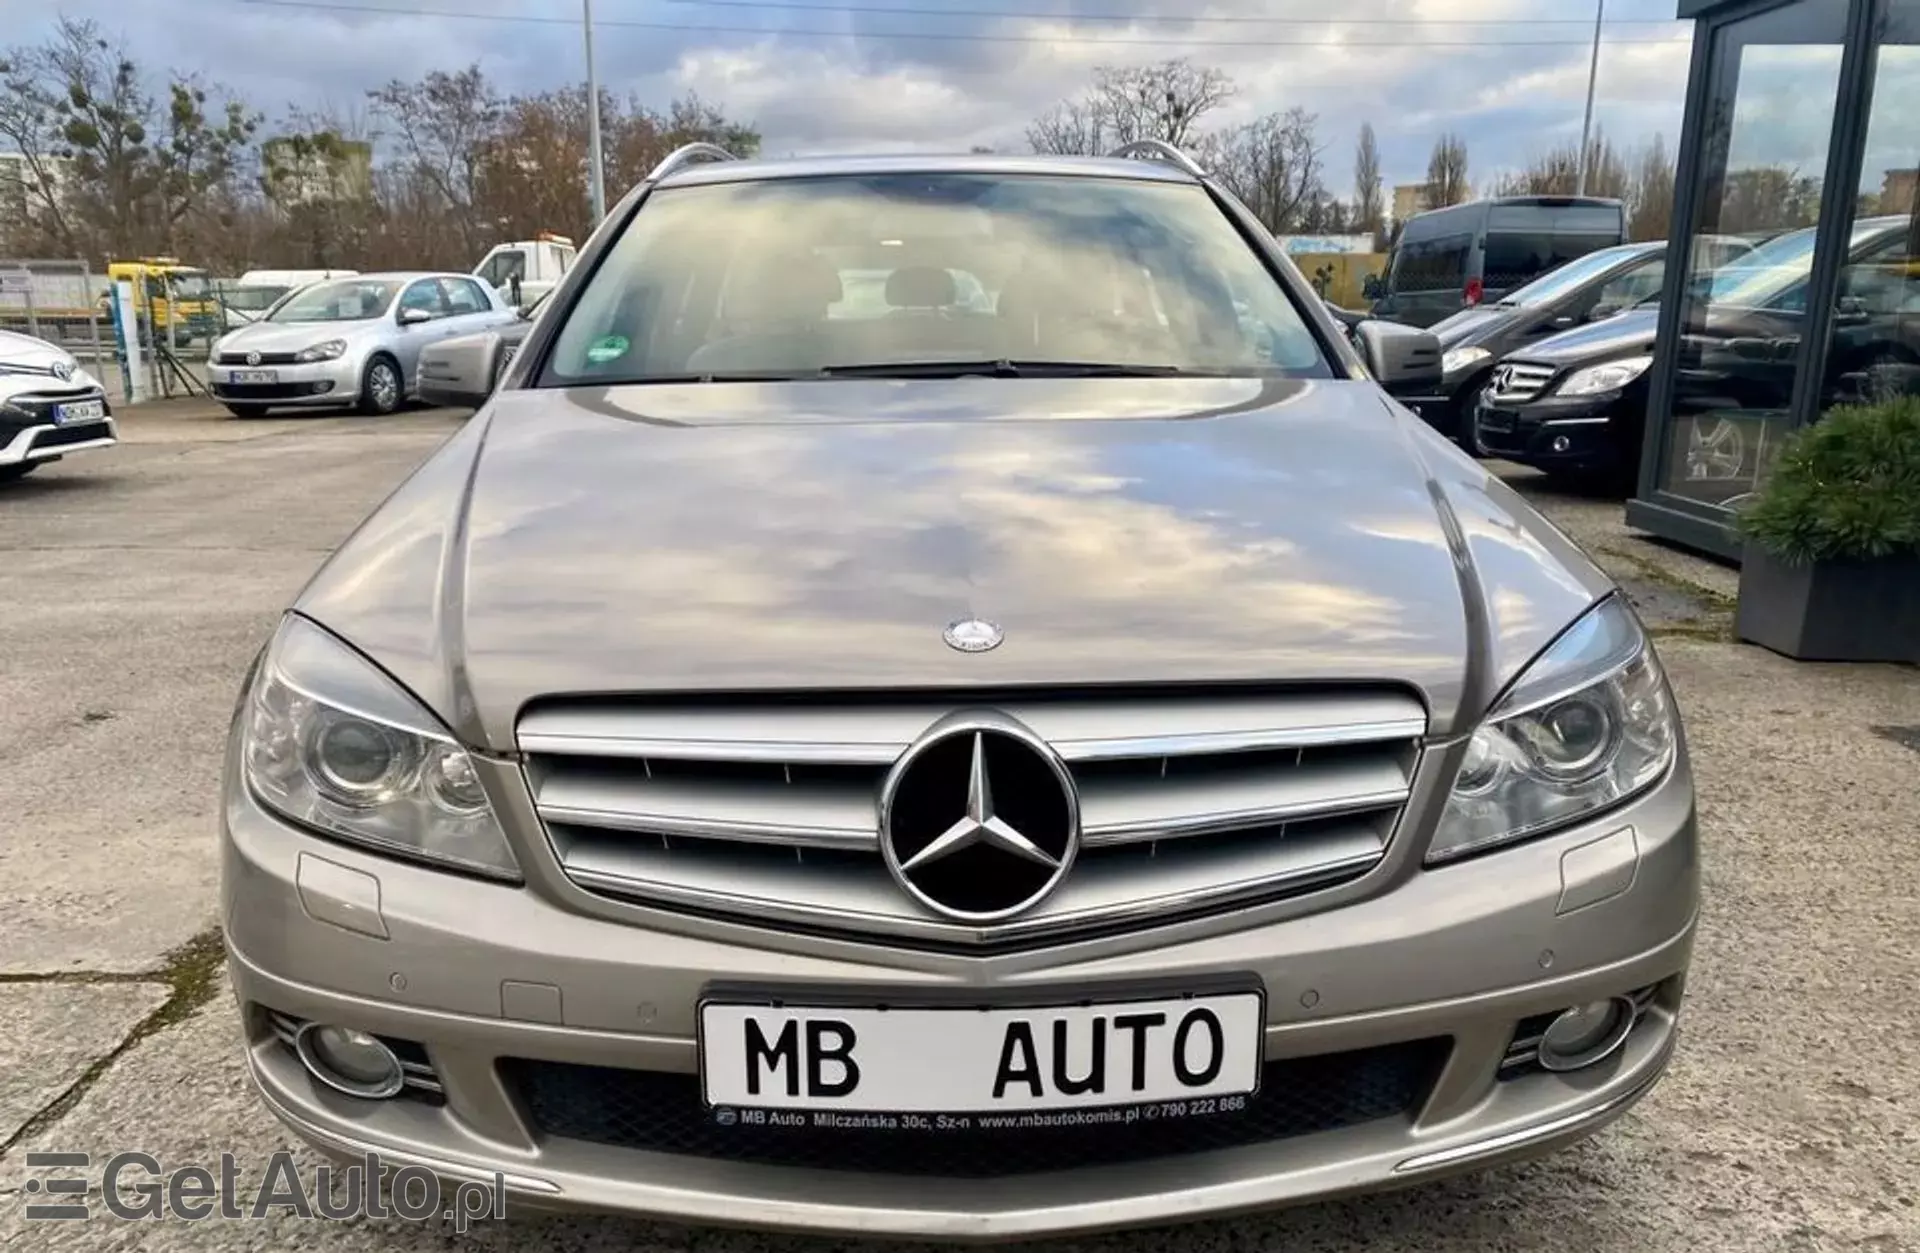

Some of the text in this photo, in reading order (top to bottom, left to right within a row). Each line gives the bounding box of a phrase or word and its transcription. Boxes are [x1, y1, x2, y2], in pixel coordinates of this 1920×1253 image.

[744, 1007, 1225, 1099] MB AUTO
[741, 1110, 765, 1125] MB
[769, 1112, 805, 1126] Auto
[814, 1112, 897, 1128] Milczańska
[901, 1114, 932, 1130] 30c,
[936, 1114, 970, 1129] Sz-n
[979, 1107, 1140, 1129] www.mbautokomis.pl
[1161, 1103, 1185, 1118] 790
[1190, 1099, 1215, 1115] 222
